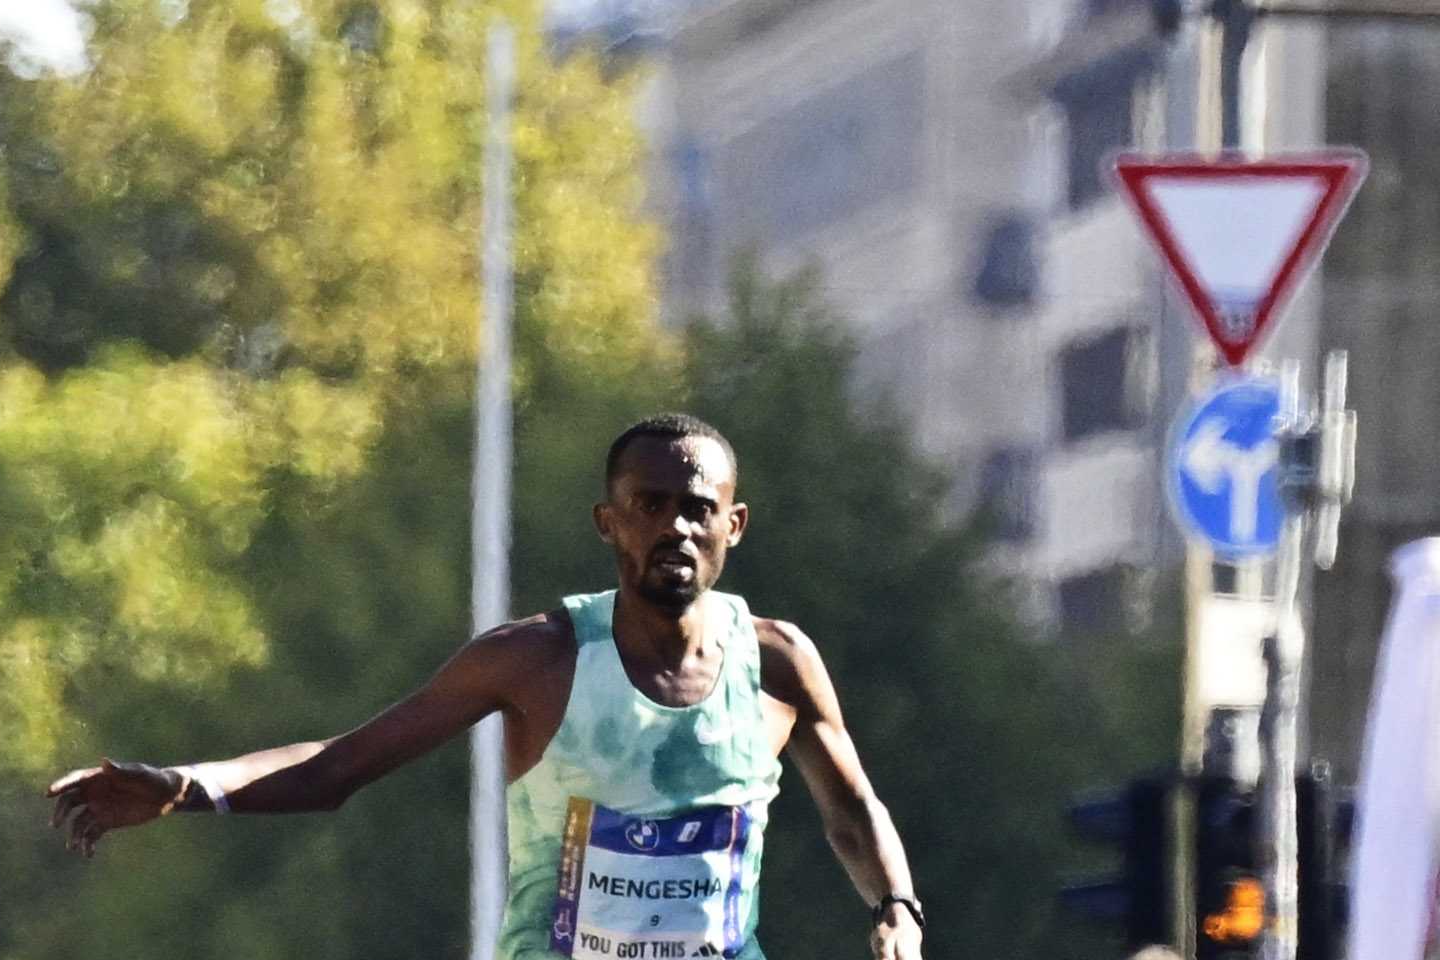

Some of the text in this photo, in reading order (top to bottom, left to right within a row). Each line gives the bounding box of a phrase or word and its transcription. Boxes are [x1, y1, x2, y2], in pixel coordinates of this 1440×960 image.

[588, 872, 722, 900] MENGESHA
[649, 914, 660, 927] 9
[580, 932, 685, 958] YOU GOT THIS
